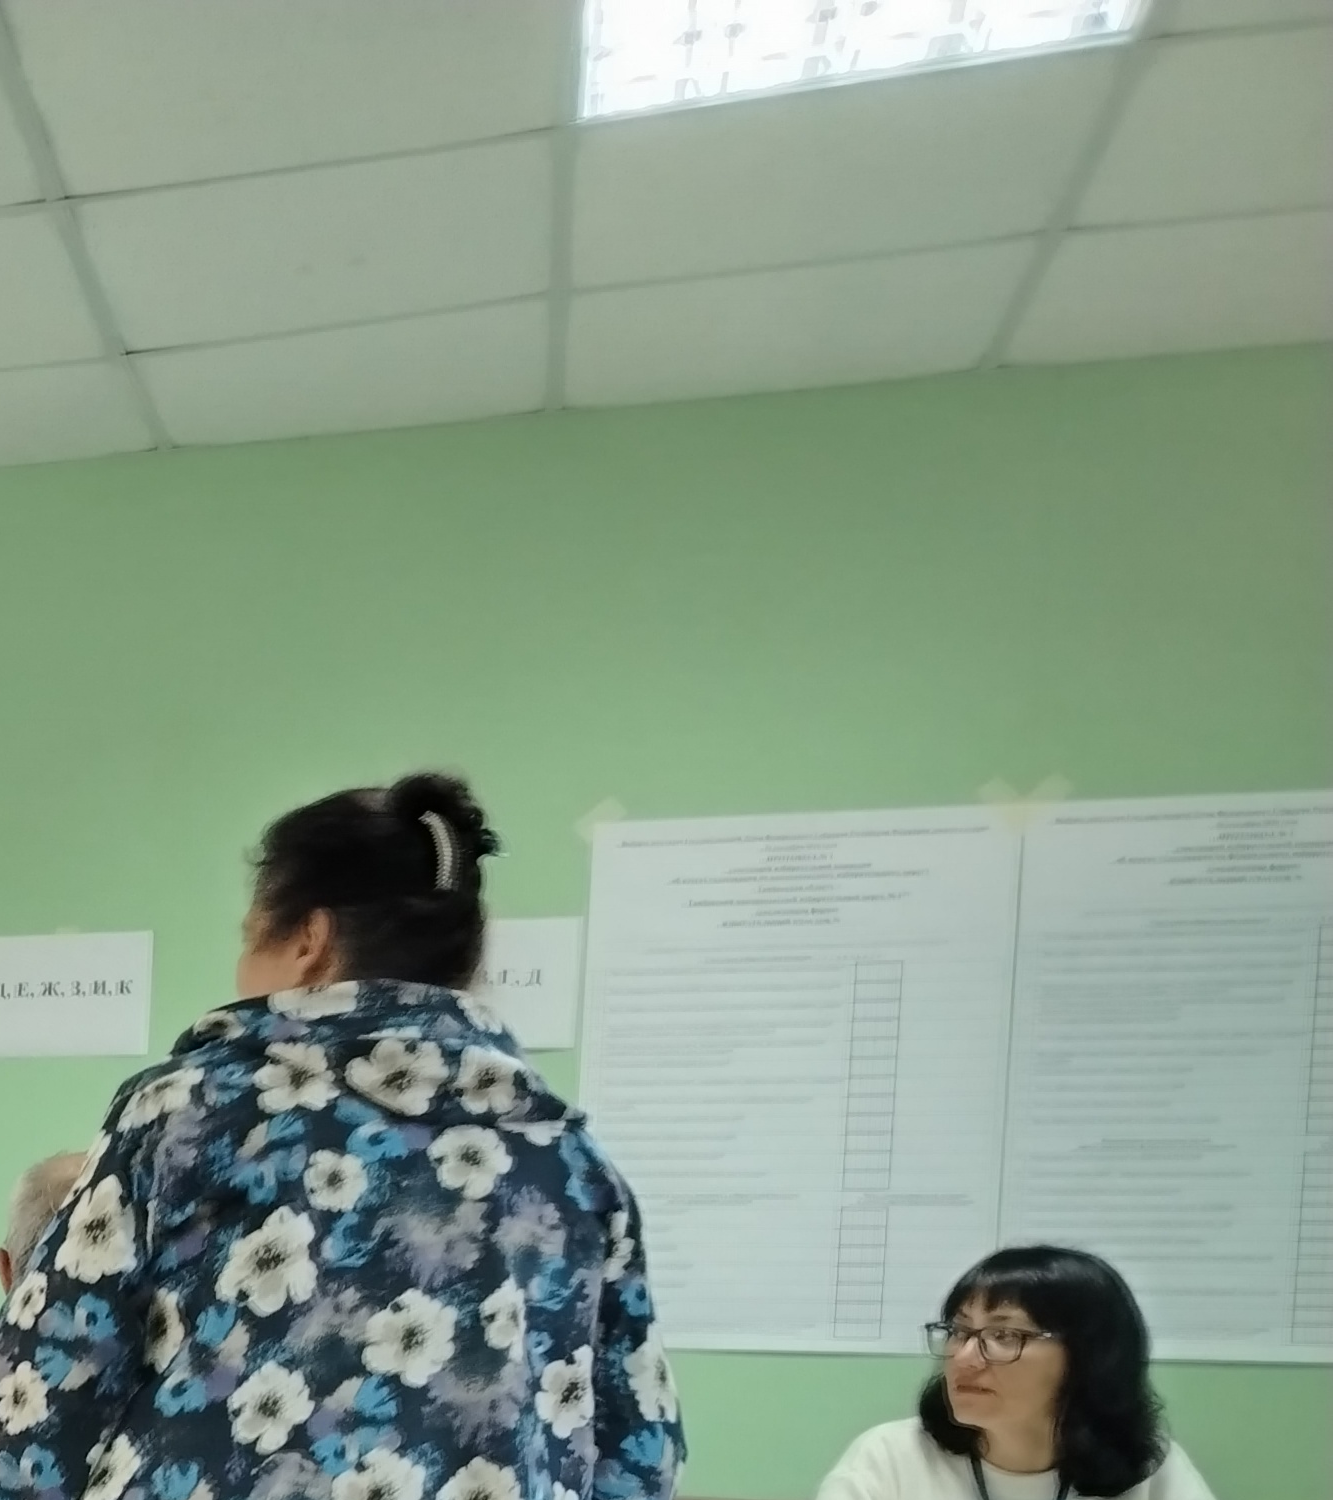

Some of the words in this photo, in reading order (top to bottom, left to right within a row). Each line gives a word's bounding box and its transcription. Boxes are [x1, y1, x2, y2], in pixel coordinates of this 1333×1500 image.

[13, 981, 35, 1000] Е,
[37, 980, 65, 998] Ж,
[70, 980, 86, 998] З,
[88, 979, 112, 997] И,
[115, 979, 134, 996] К
